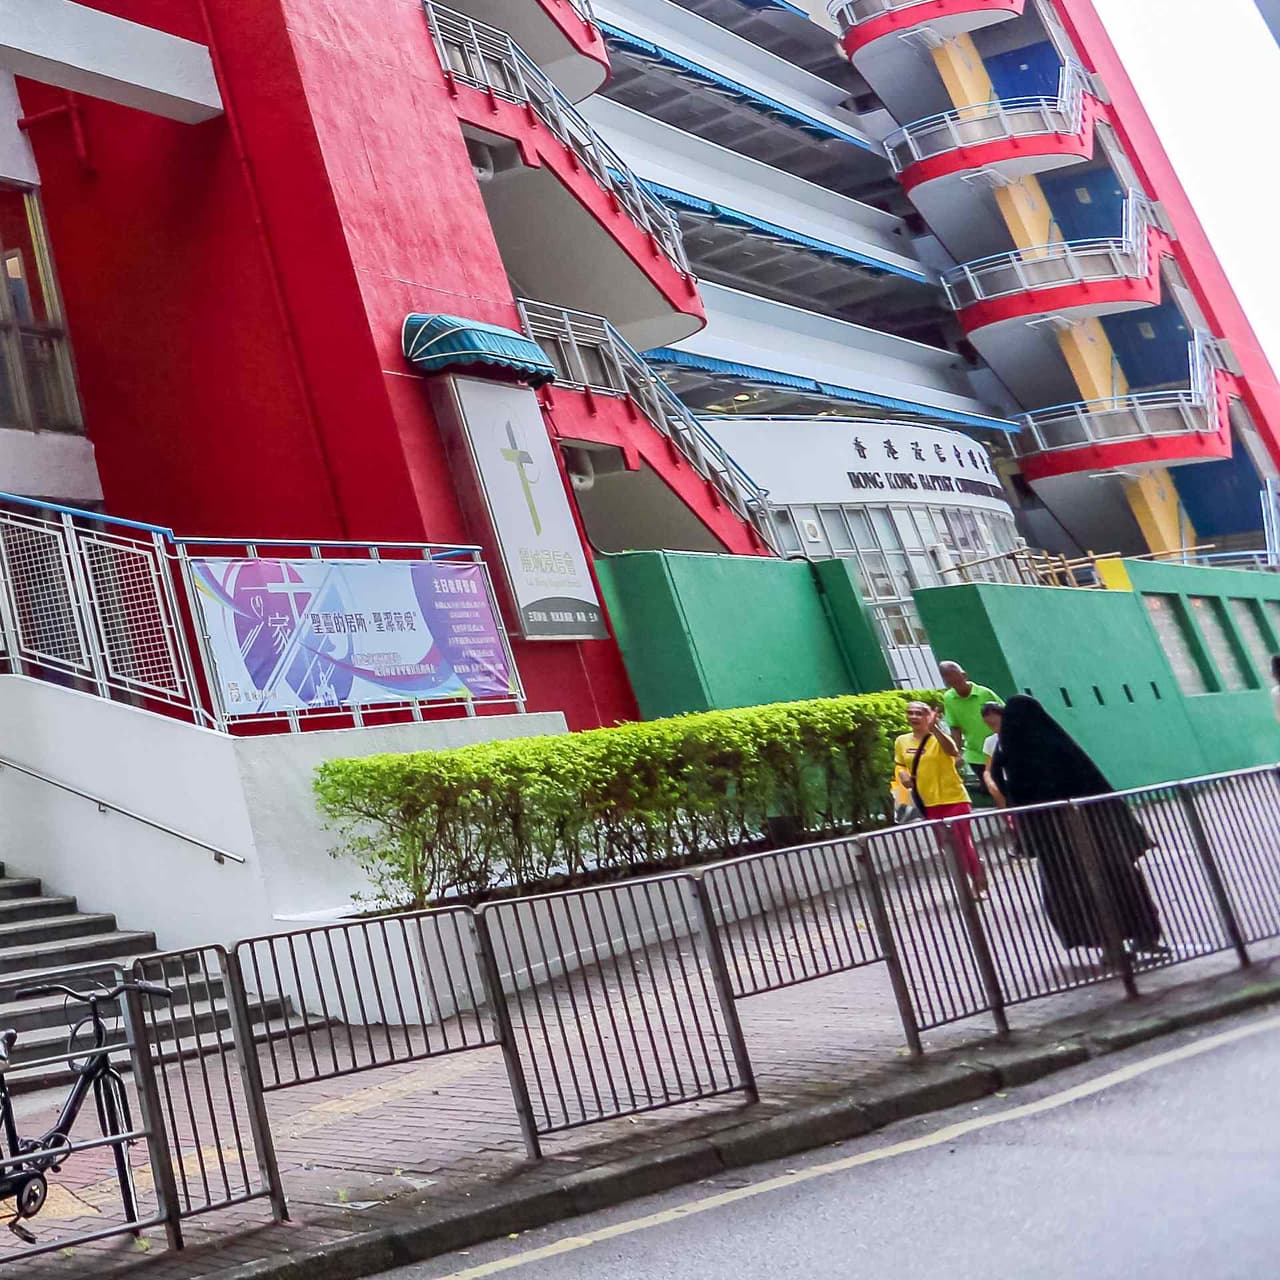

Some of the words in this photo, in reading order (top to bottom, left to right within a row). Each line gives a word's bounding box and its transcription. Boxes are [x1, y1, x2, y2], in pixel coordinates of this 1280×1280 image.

[847, 471, 885, 489] HONG
[885, 472, 918, 490] KONG
[918, 473, 955, 492] BAPTIST
[268, 612, 292, 655] 家
